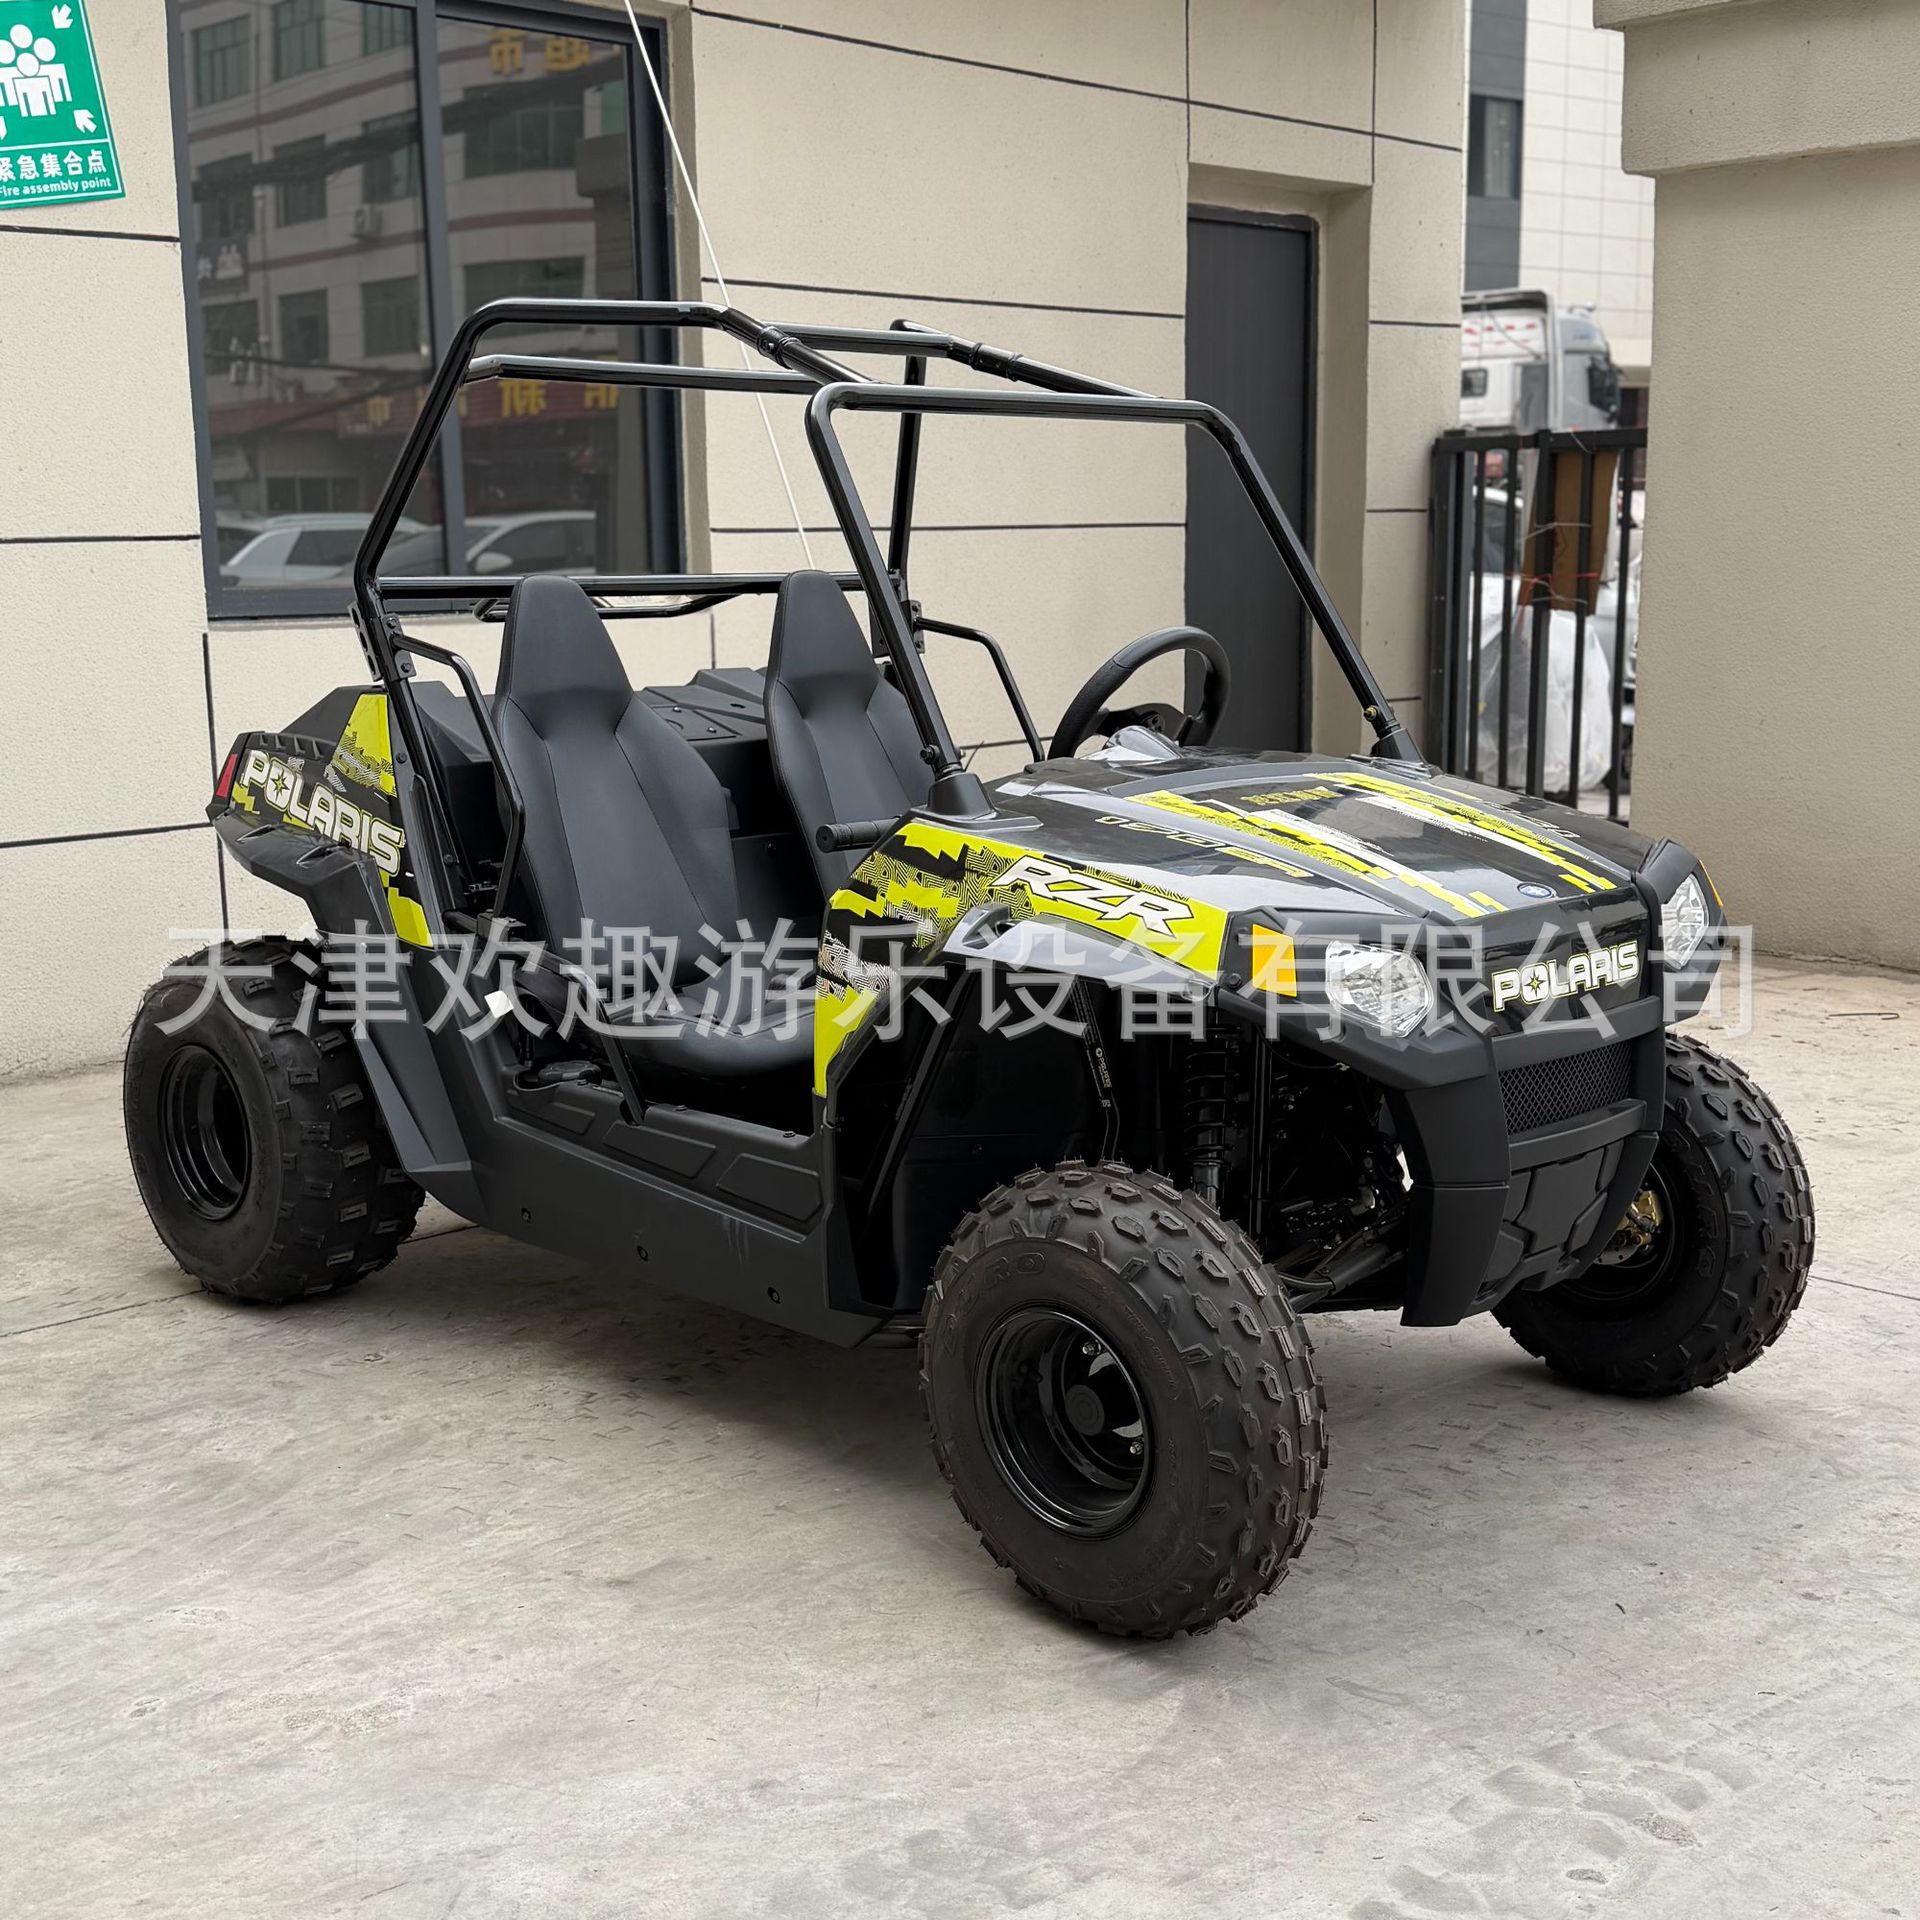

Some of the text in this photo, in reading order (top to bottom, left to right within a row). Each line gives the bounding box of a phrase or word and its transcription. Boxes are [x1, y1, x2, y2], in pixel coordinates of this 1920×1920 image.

[0, 149, 106, 182] 紧急集合点
[22, 180, 79, 195] assembly
[81, 177, 112, 191] point
[240, 749, 405, 876] POLARIS
[987, 855, 1194, 939] RZR
[1492, 940, 1639, 1013] POLARIS
